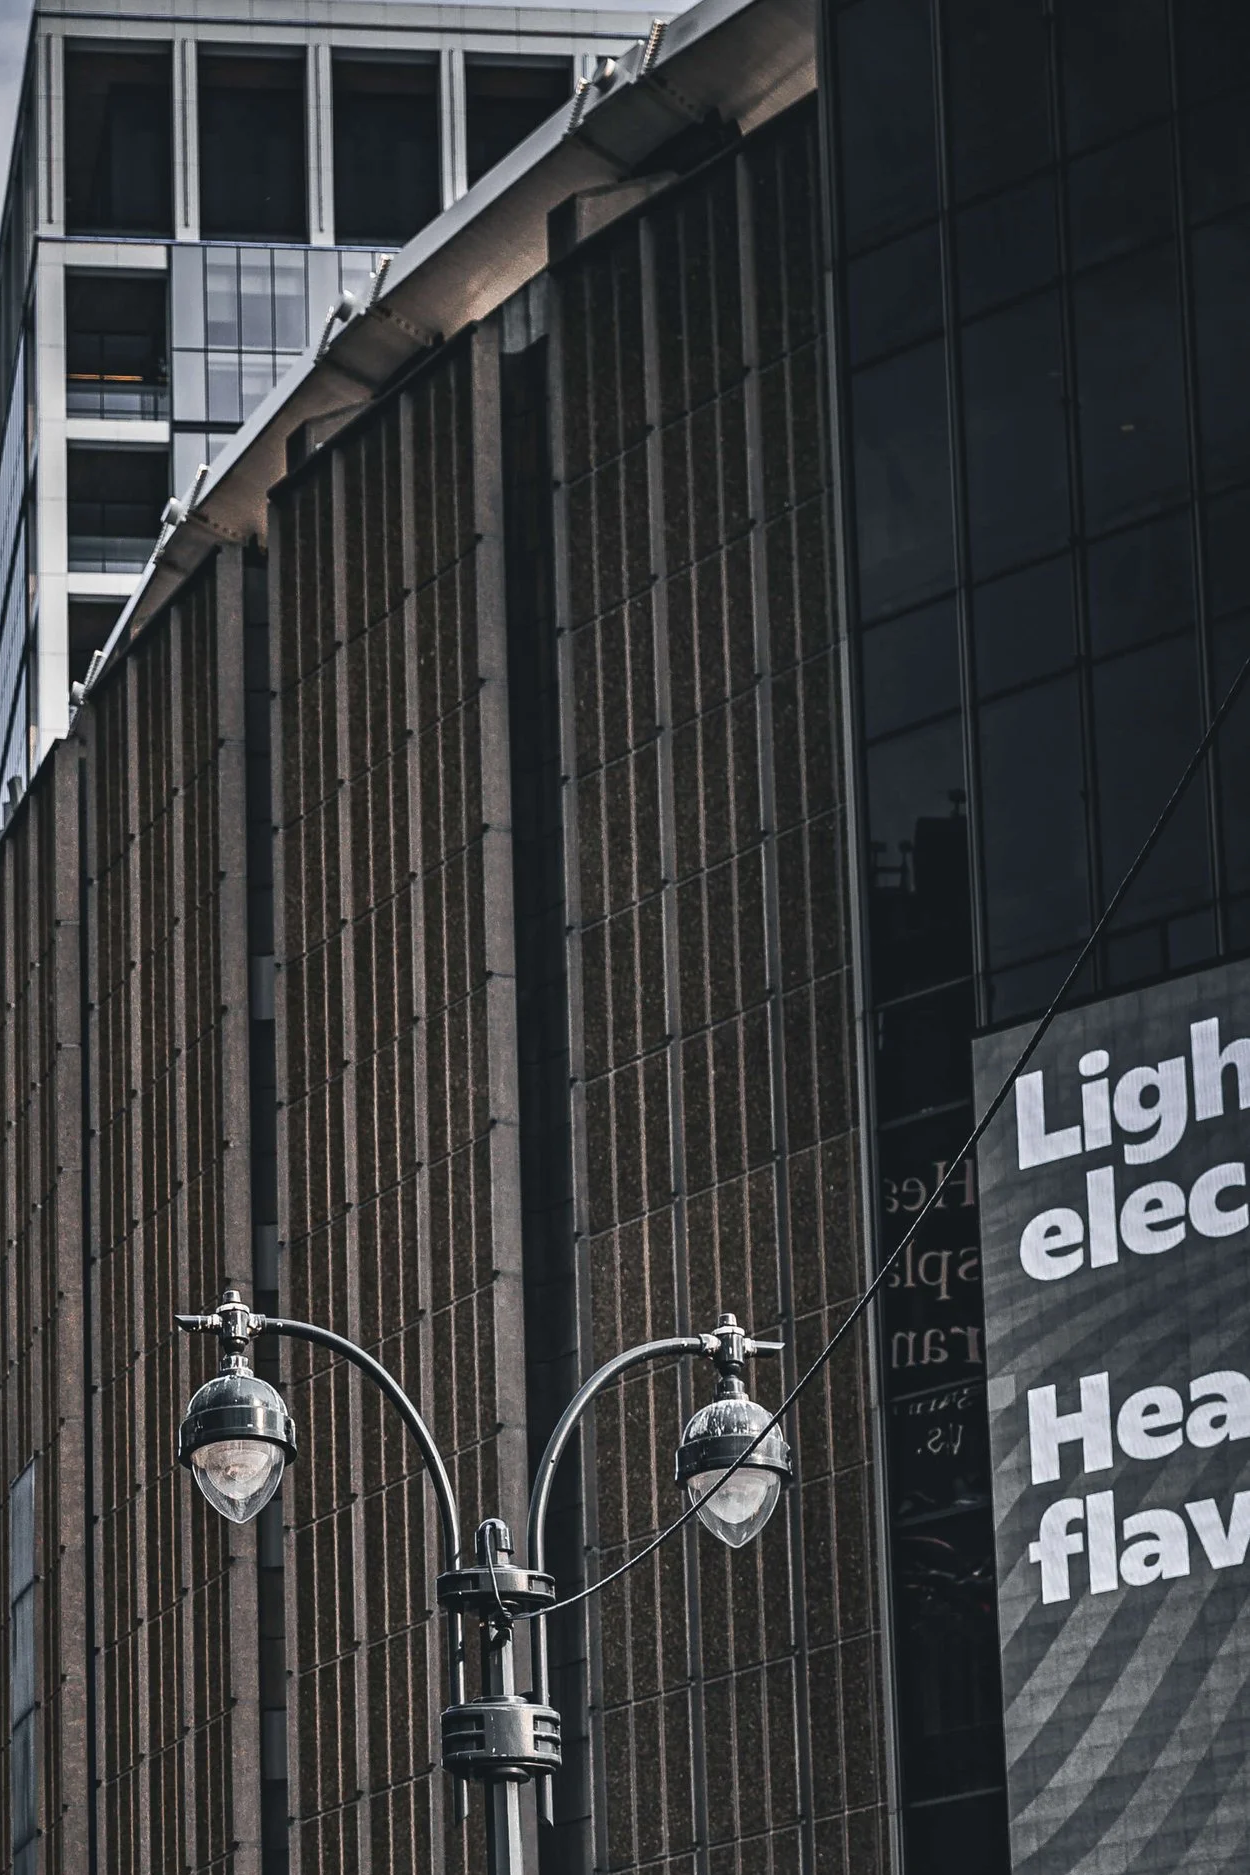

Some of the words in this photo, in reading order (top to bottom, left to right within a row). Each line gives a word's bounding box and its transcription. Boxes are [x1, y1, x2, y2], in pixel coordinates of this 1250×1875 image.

[1015, 1016, 1250, 1170] Ligh
[1019, 1161, 1250, 1281] elec
[1027, 1370, 1250, 1486] Hea
[1029, 1488, 1250, 1606] flav
